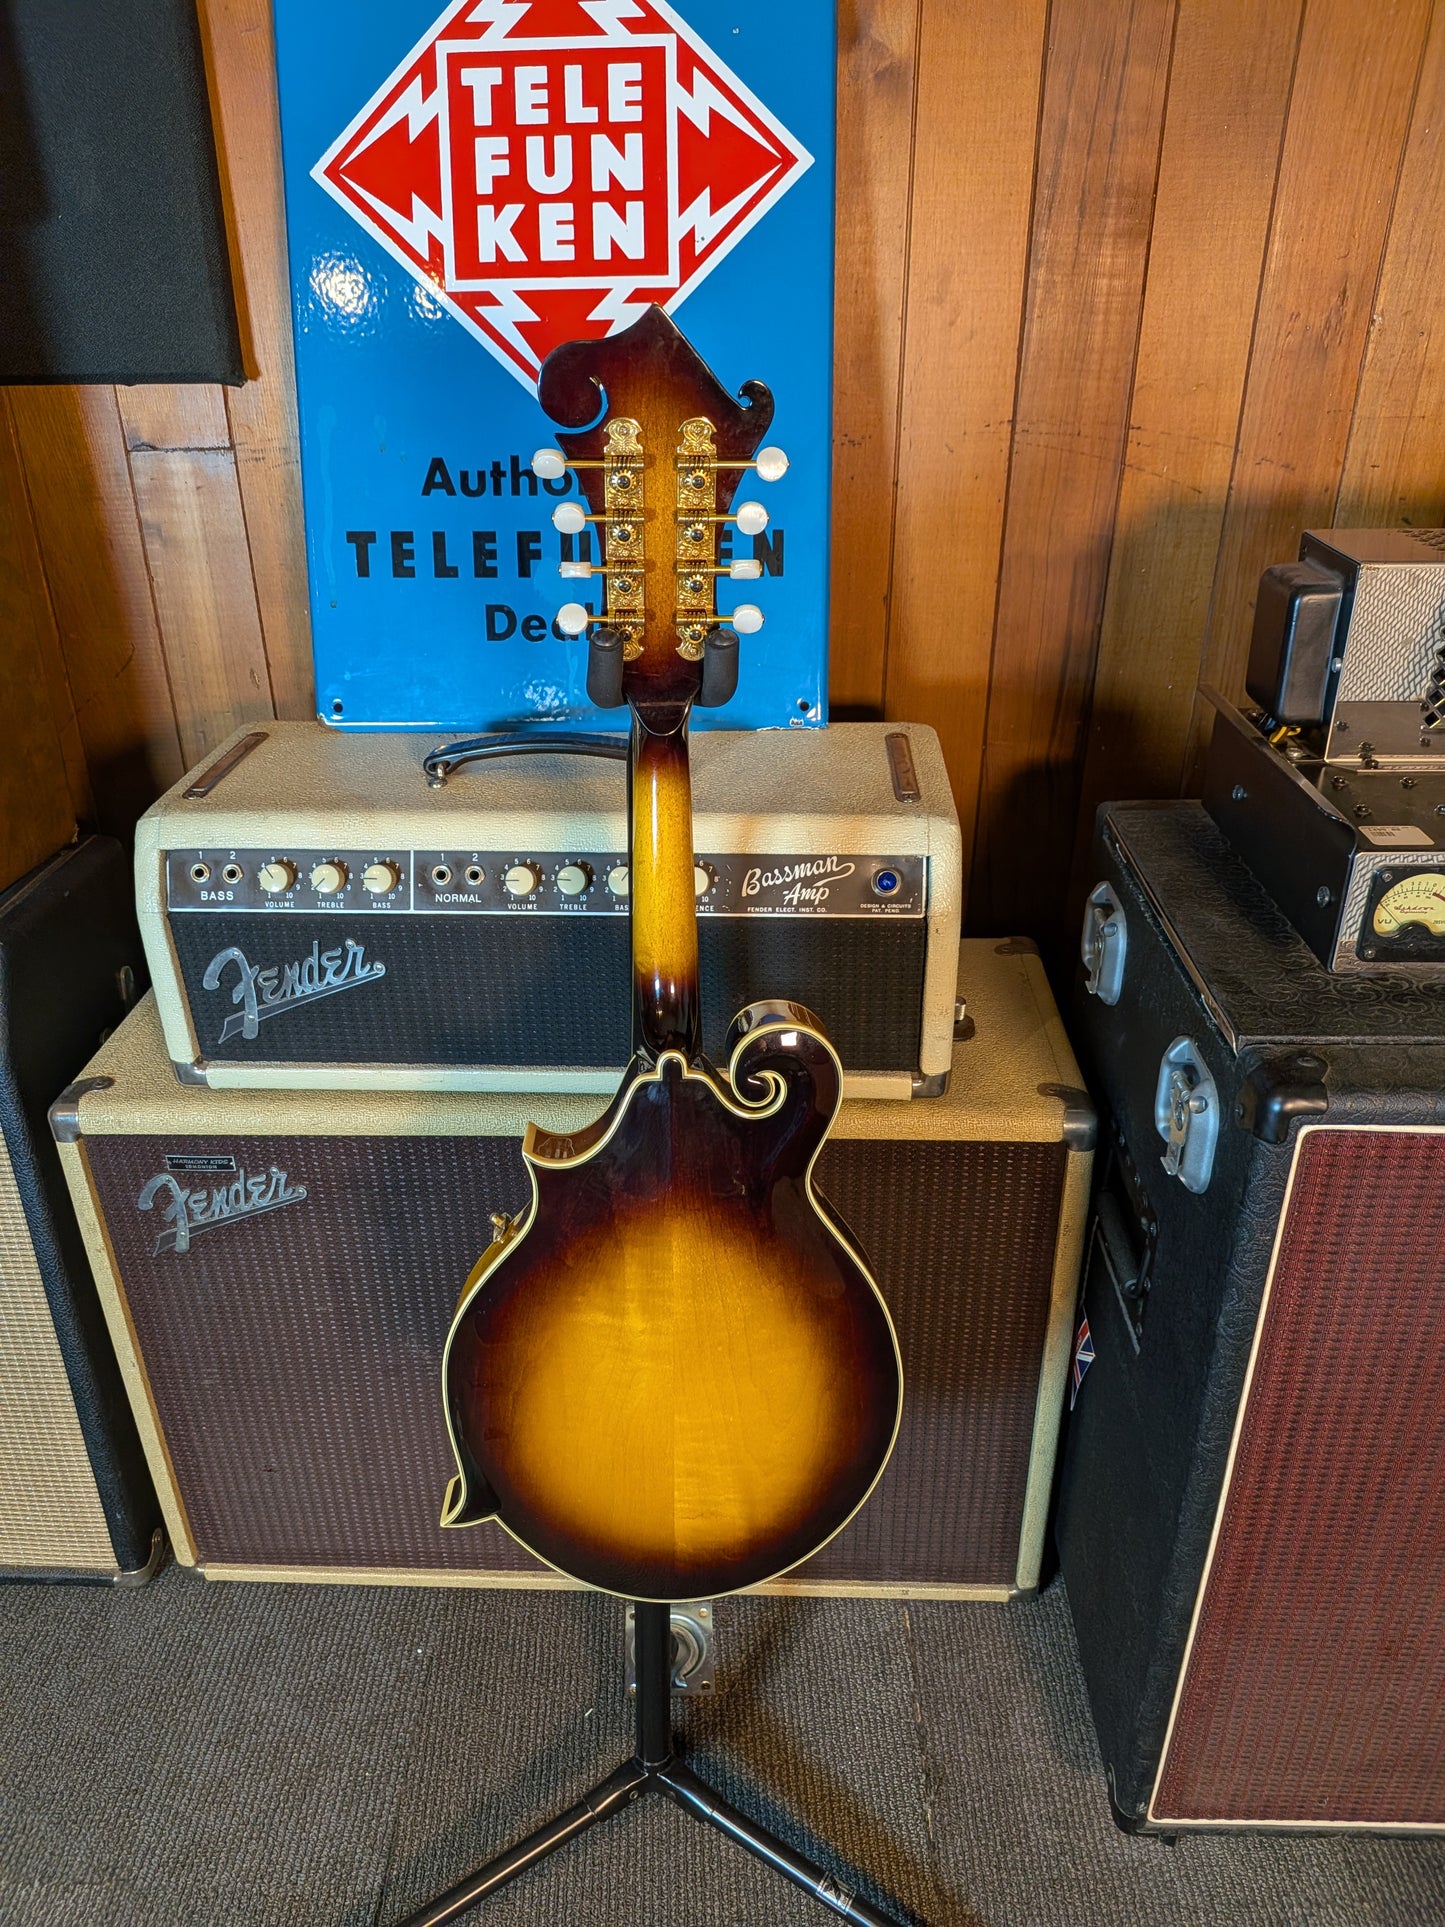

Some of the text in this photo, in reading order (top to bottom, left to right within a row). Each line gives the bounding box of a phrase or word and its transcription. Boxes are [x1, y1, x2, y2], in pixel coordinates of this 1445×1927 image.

[461, 62, 643, 126] TELE
[475, 133, 644, 195] FUN
[478, 201, 645, 263] KEN
[230, 851, 236, 859] 2
[472, 853, 478, 861] 2
[201, 891, 234, 901] BASS
[742, 856, 855, 897] Bassman
[783, 882, 829, 905] Amp
[435, 894, 481, 903] NORMAL
[203, 939, 385, 1044] Fender
[138, 1167, 308, 1257] Fender
